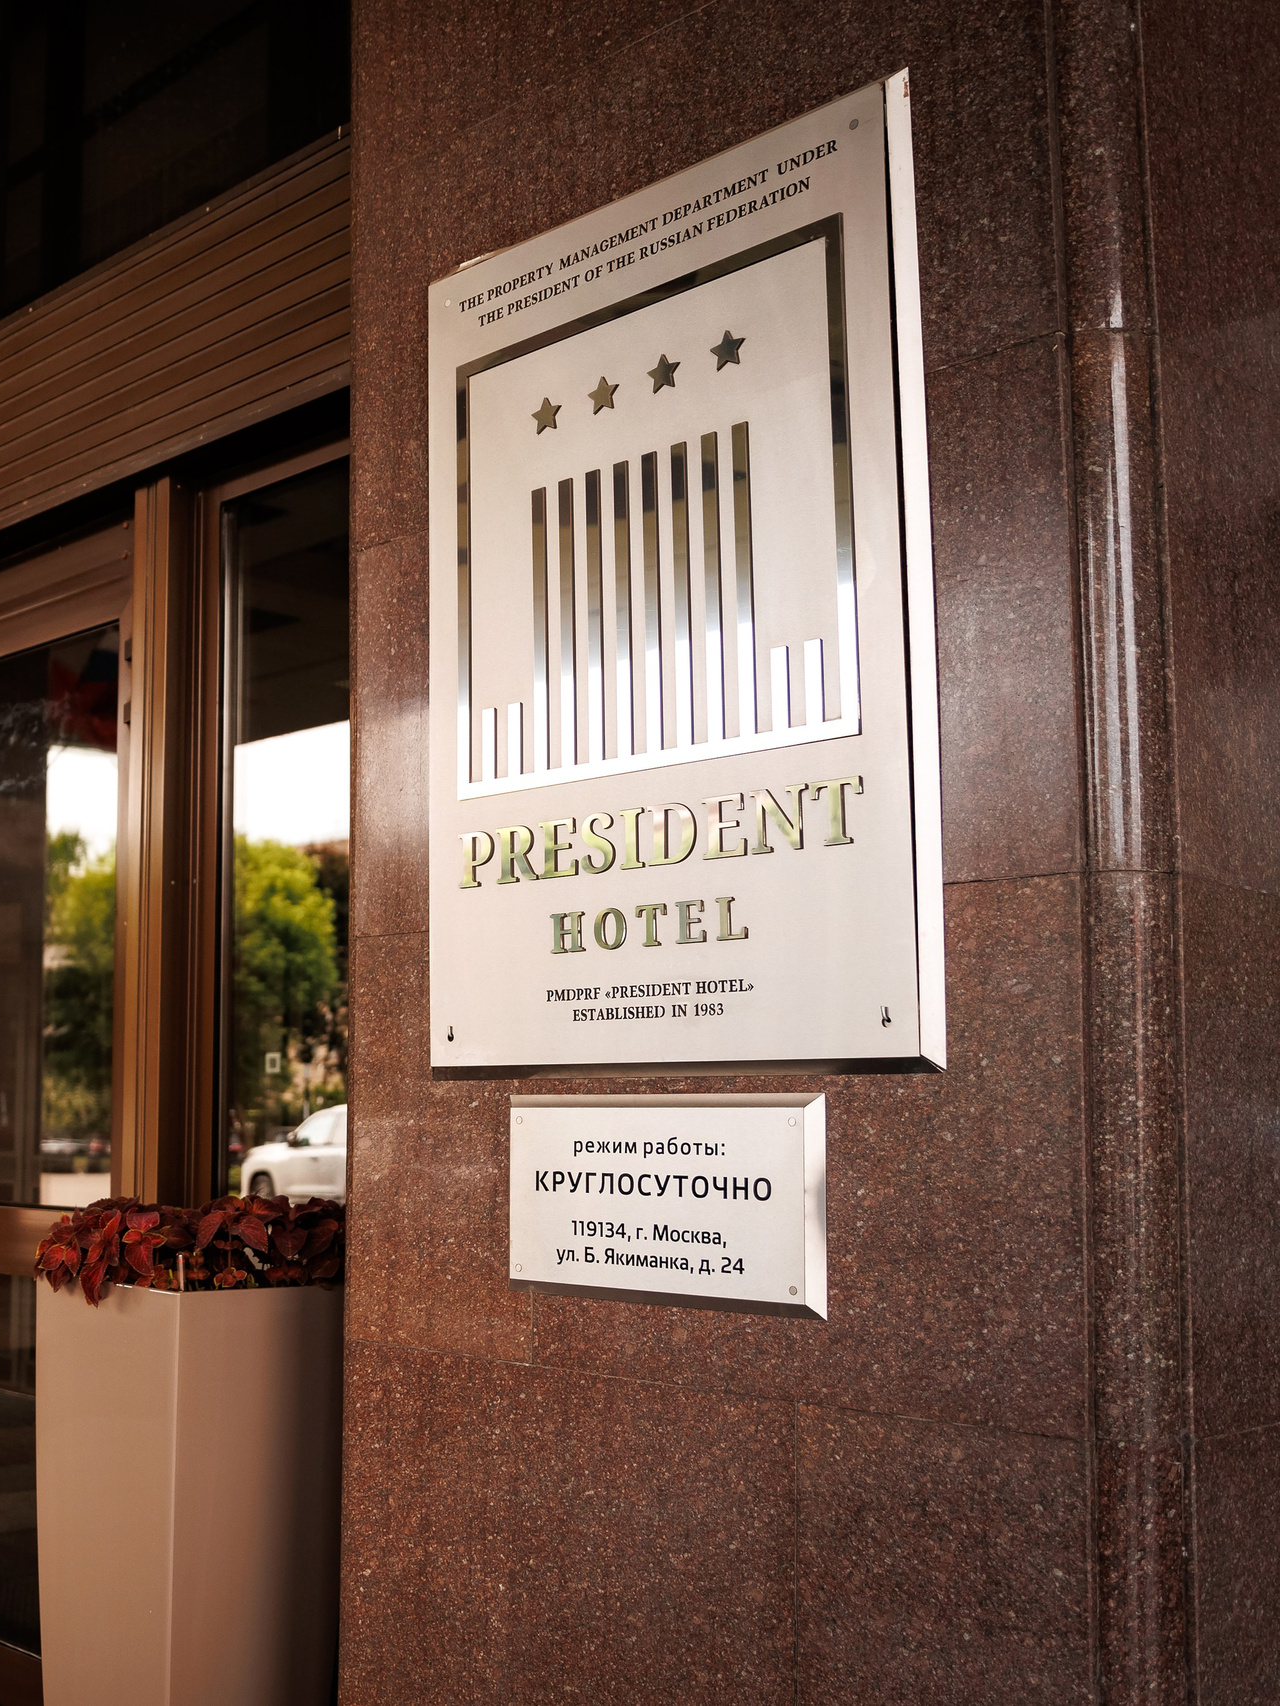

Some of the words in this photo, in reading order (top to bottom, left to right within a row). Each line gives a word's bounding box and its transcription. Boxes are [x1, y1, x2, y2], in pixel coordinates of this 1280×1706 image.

[459, 293, 484, 313] THE
[487, 262, 554, 301] PROPERTY
[559, 217, 658, 271] MANAGEMENT
[662, 168, 768, 226] DEPARTMENT
[776, 139, 838, 176] UNDER
[478, 307, 504, 327] THE
[507, 274, 580, 316] PRESIDENT
[584, 265, 603, 283] OF
[607, 250, 635, 273] THE
[639, 221, 704, 261] RUSSIAN
[707, 176, 811, 232] FEDERATION
[458, 775, 864, 889] PRESIDENT
[549, 896, 749, 954] HOTEL
[546, 986, 601, 1002] PMDPRF
[604, 981, 692, 999] «PRESIDENT
[695, 978, 754, 995] HOTEL»
[572, 1005, 665, 1022] ESTABLISHED
[671, 1003, 687, 1018] IN
[693, 1002, 724, 1017] 1983
[573, 1138, 637, 1157] режим
[643, 1136, 726, 1158] работы:
[535, 1170, 772, 1202] КРУГЛОСУТОЧНО
[571, 1219, 631, 1242] 119134,
[635, 1226, 648, 1240] г.
[653, 1224, 727, 1248] Москва,
[556, 1247, 579, 1264] ул.
[584, 1246, 600, 1264] Б.
[604, 1249, 694, 1274] Якиманка,
[698, 1258, 715, 1275] д.
[720, 1256, 745, 1275] 24
